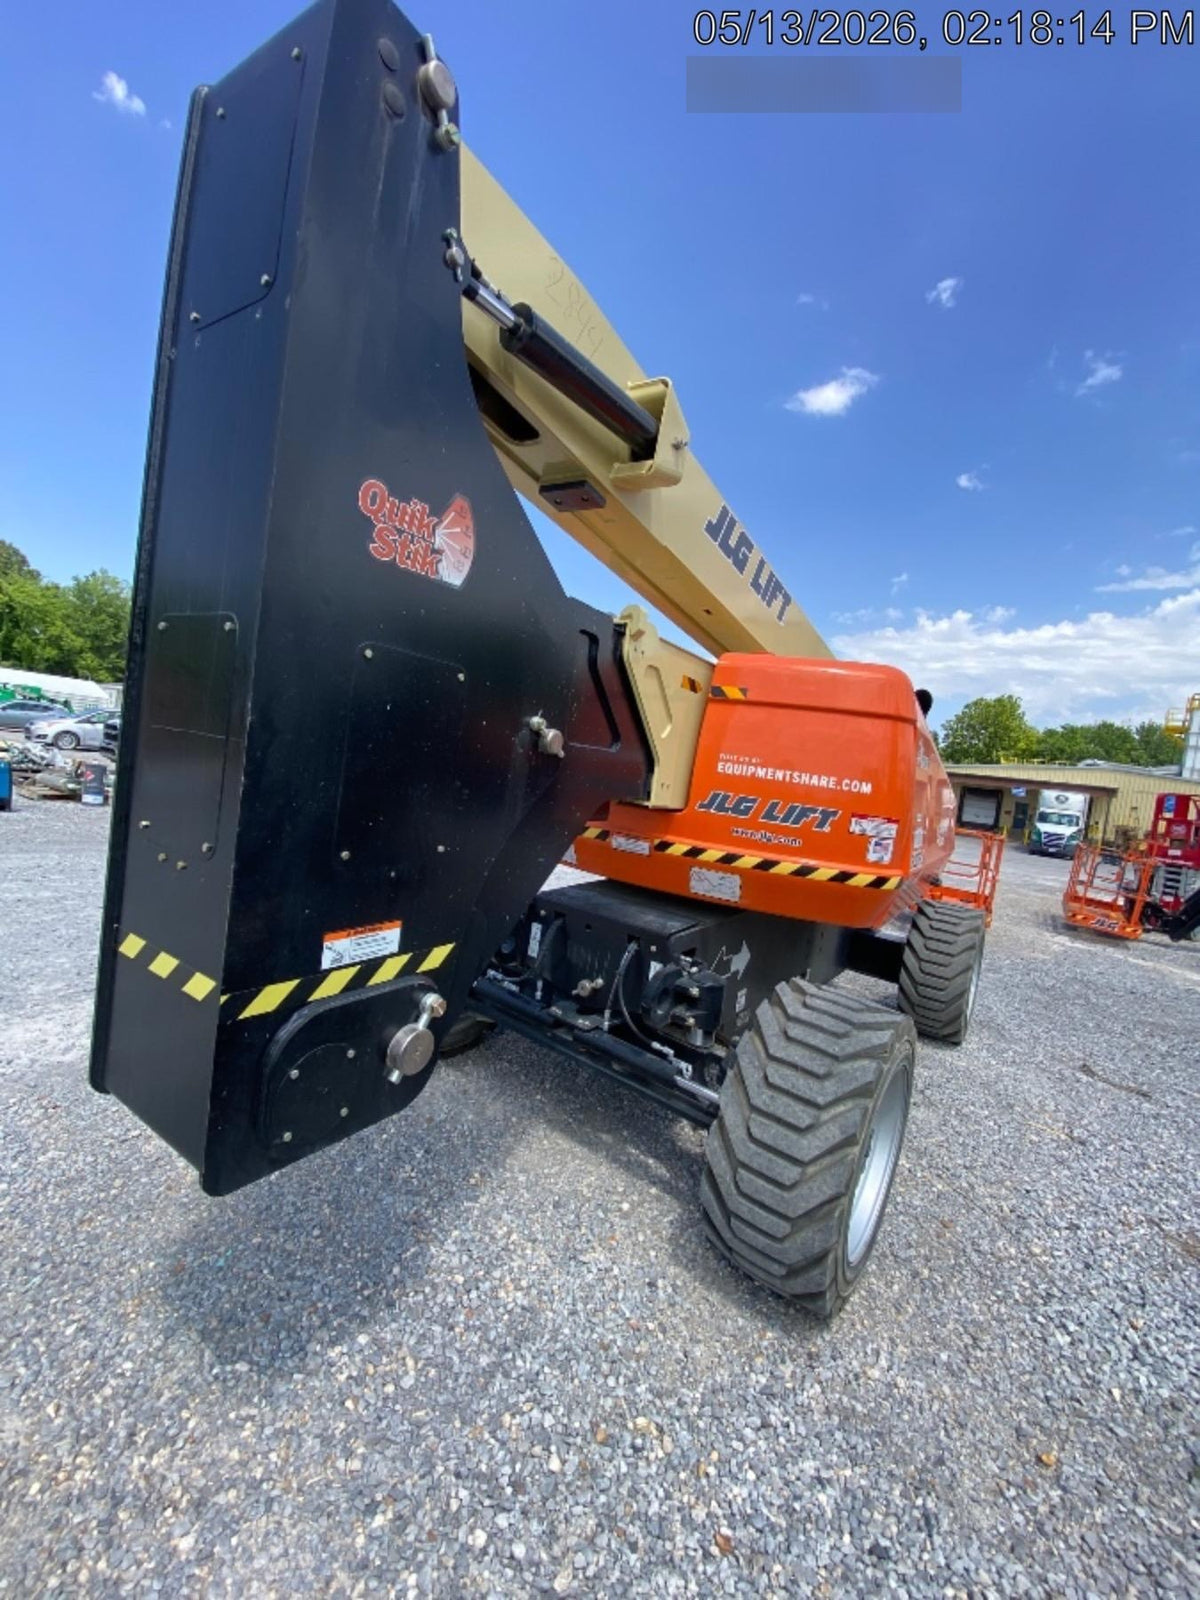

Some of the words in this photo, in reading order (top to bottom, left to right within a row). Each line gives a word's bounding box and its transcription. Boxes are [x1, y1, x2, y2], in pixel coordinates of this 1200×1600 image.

[359, 479, 439, 542] Quik
[369, 523, 441, 579] Stik
[702, 502, 756, 577] JLG
[748, 554, 792, 625] LIFT
[716, 761, 873, 795] EQUIPMENTSHARE.COM
[694, 790, 761, 818] JLG
[758, 799, 842, 832] LIFT
